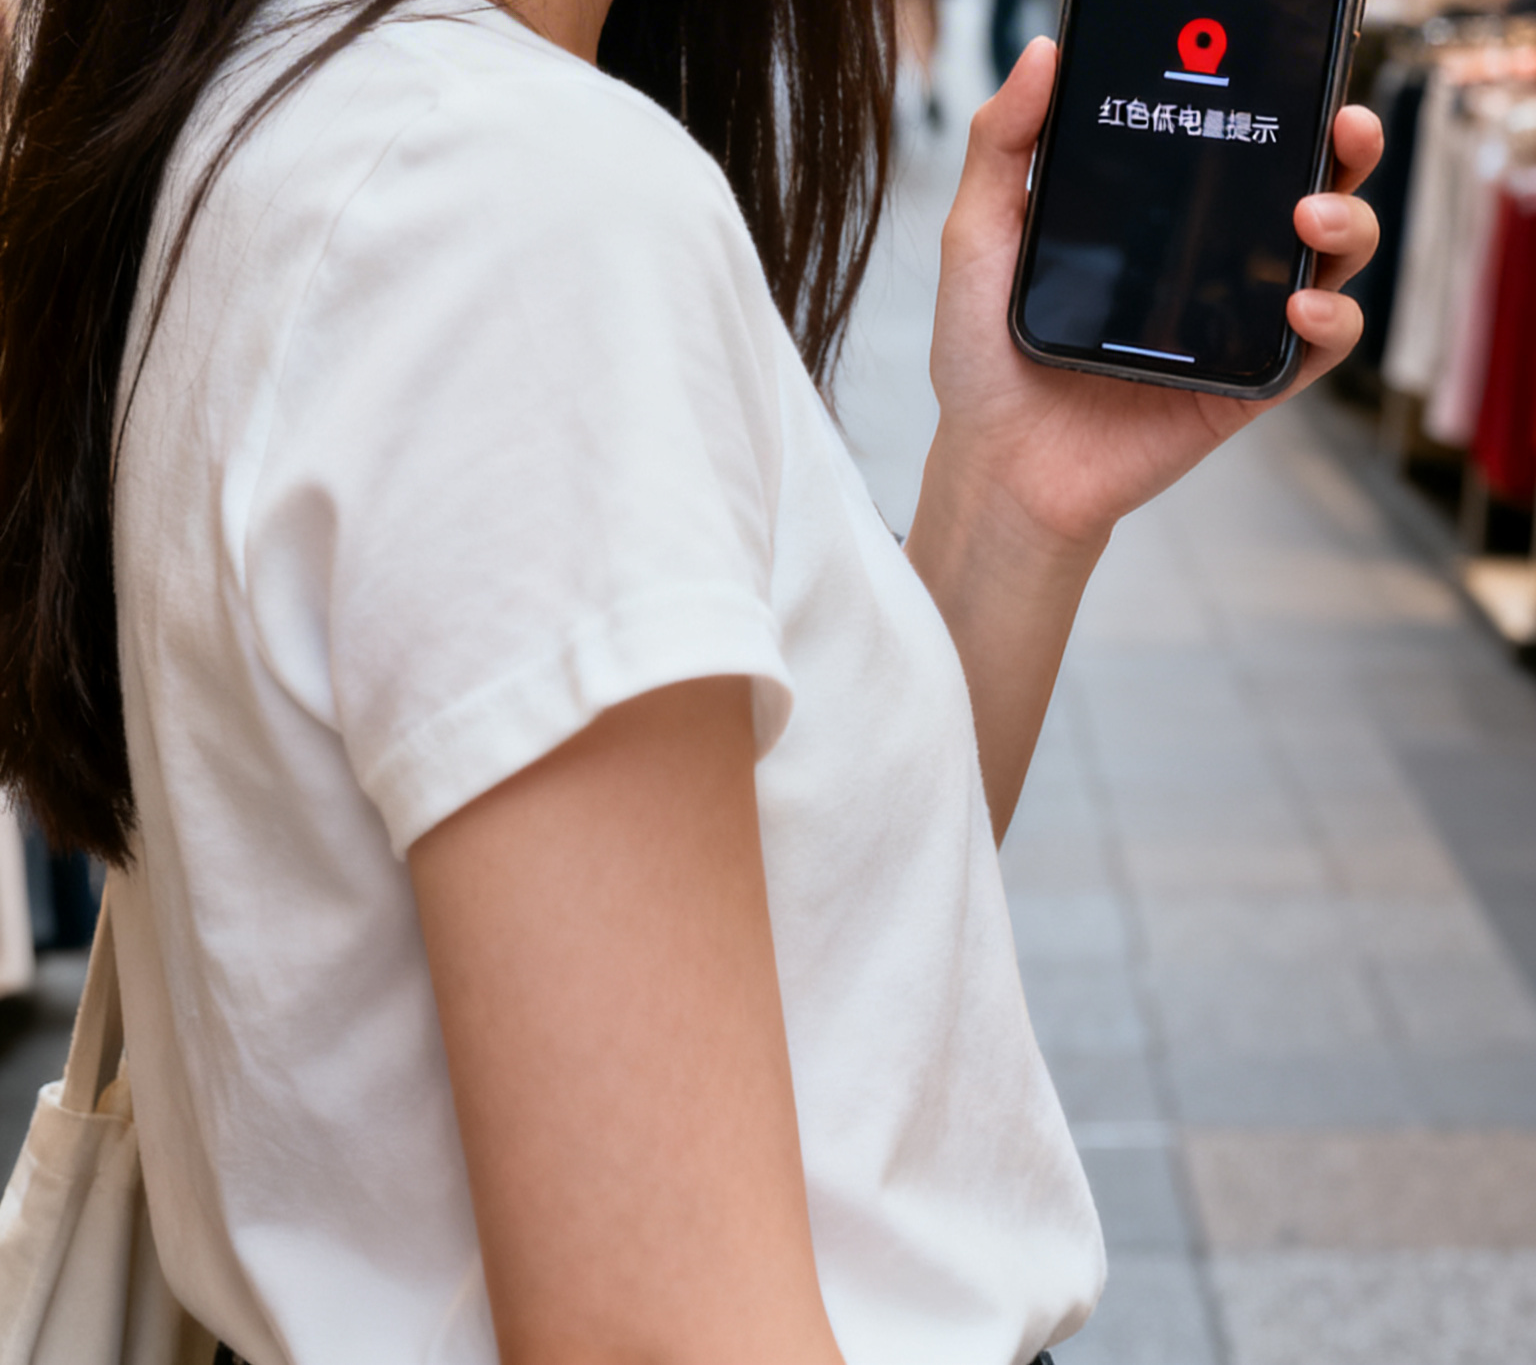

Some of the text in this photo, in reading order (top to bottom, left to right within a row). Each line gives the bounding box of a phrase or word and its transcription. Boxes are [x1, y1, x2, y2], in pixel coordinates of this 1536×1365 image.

[1098, 96, 1279, 143] 红色低电提示
